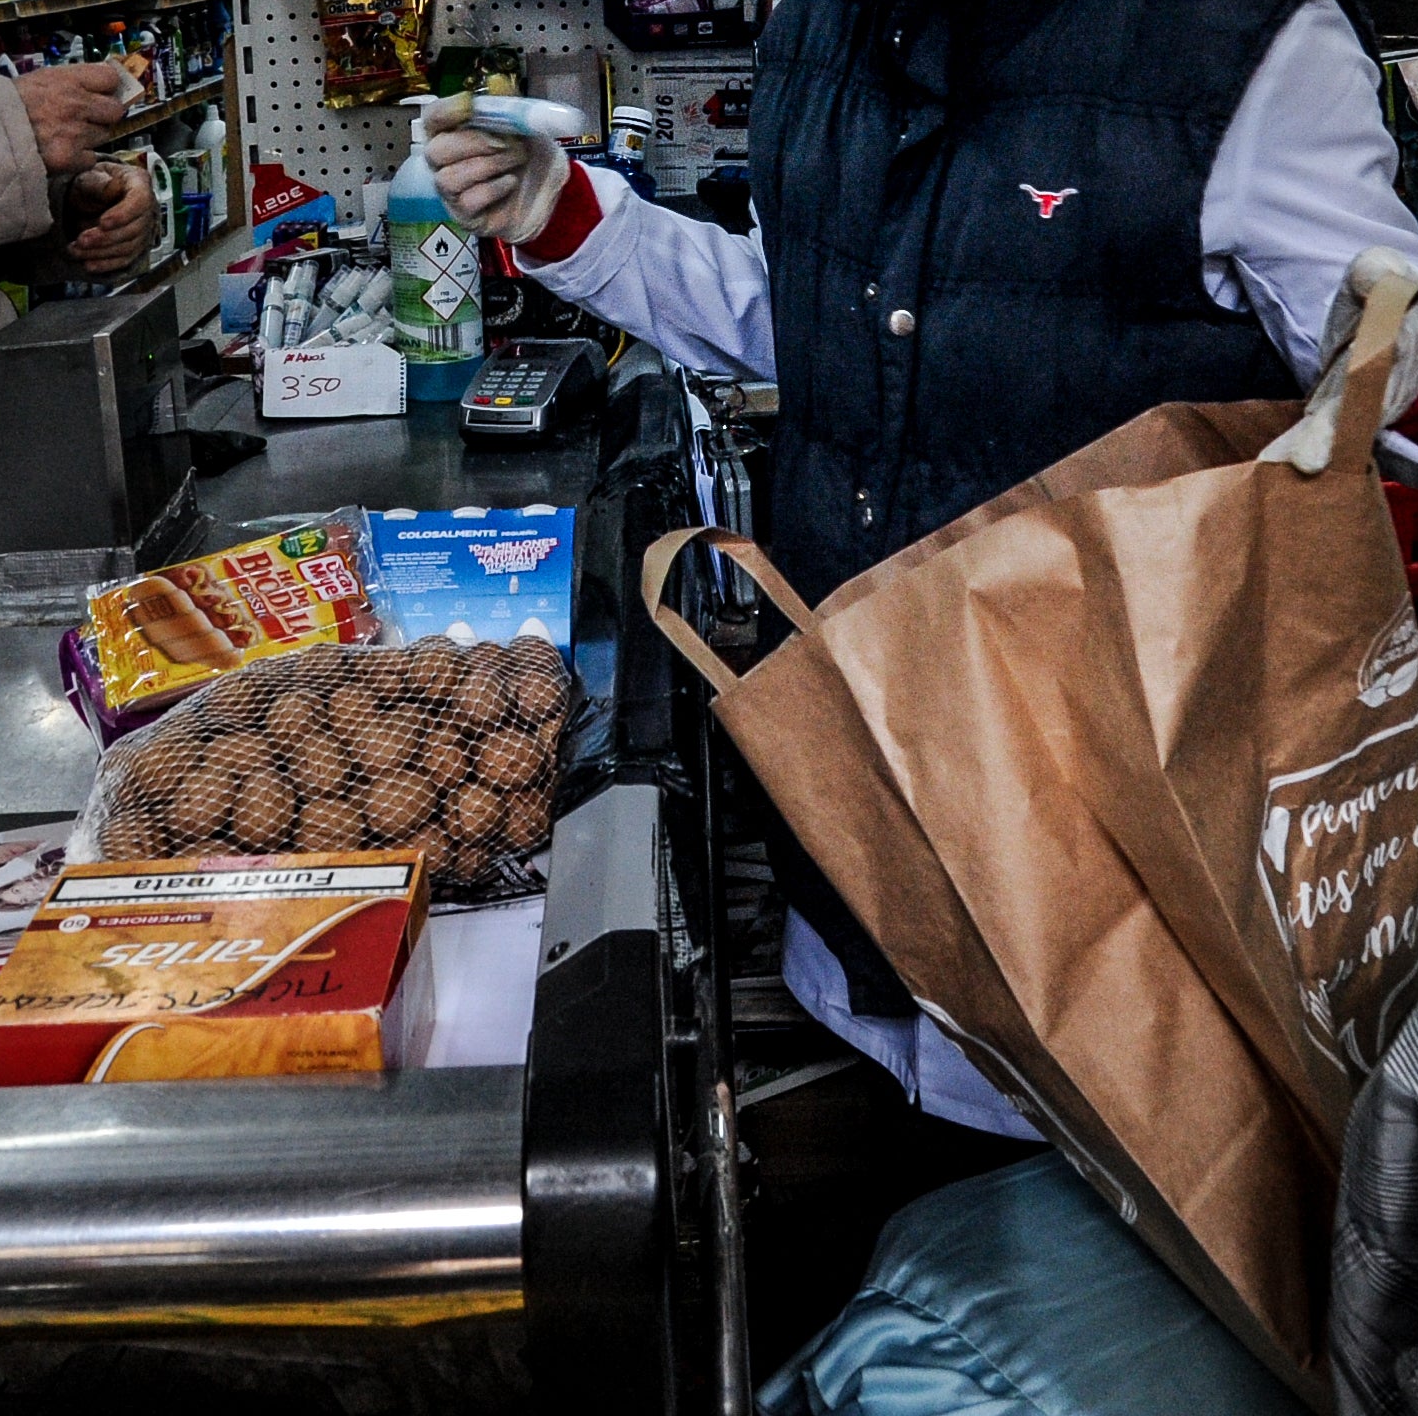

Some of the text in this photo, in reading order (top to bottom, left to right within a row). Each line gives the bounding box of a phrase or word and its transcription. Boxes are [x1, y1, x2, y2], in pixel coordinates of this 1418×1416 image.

[328, 2, 370, 16] Ositos
[656, 93, 674, 142] 2016
[397, 529, 498, 540] COLOSALMENTE
[132, 870, 334, 892] Fumar mata
[97, 913, 203, 928] SUPERIORES
